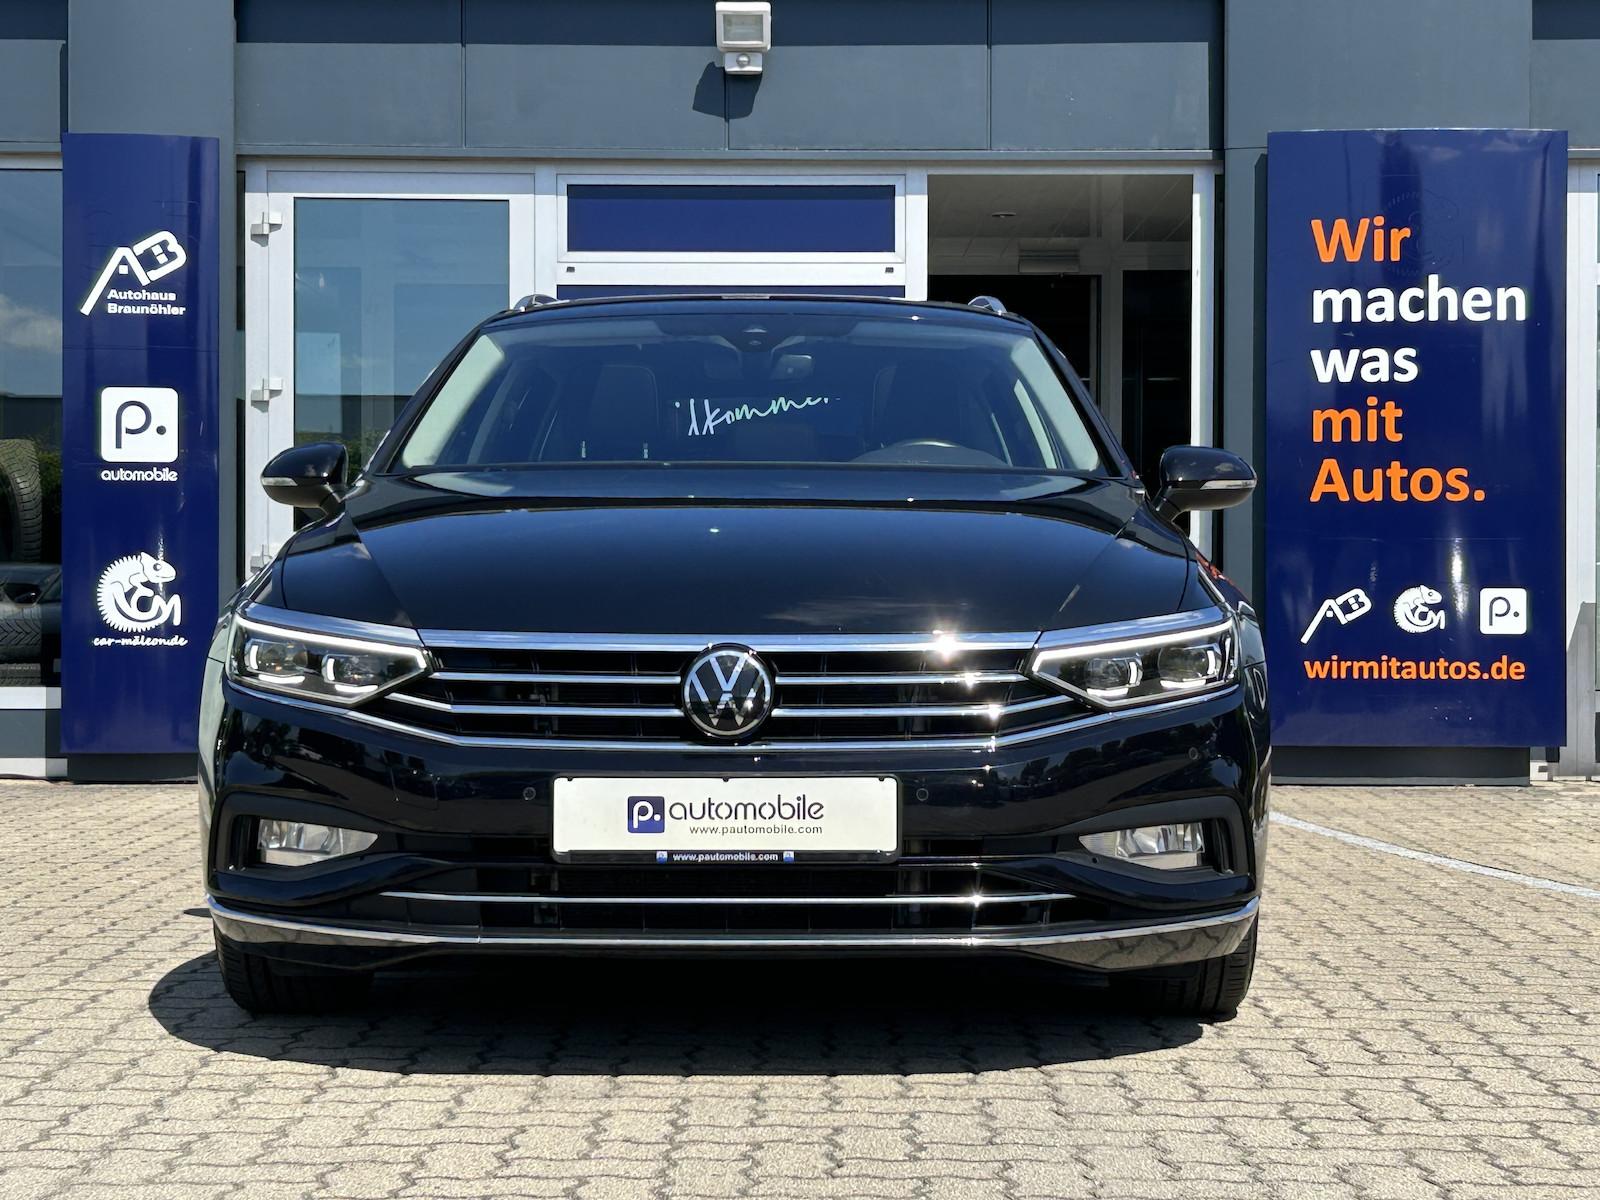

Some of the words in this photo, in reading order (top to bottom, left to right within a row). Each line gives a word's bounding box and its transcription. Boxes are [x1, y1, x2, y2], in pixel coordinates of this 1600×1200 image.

[1310, 216, 1411, 262] Wir
[107, 289, 176, 301] Autohaus
[1312, 274, 1526, 323] machen
[107, 303, 186, 315] Braunöhler
[1310, 347, 1418, 383] was
[1312, 396, 1403, 442] mit
[100, 467, 178, 481] automobile
[1310, 458, 1486, 502] Autos.
[1304, 655, 1526, 680] wirmitautos.de
[669, 794, 824, 820] automobile
[689, 824, 823, 836] www.pautomobile.com
[672, 852, 778, 862] www.pautomobile.com
